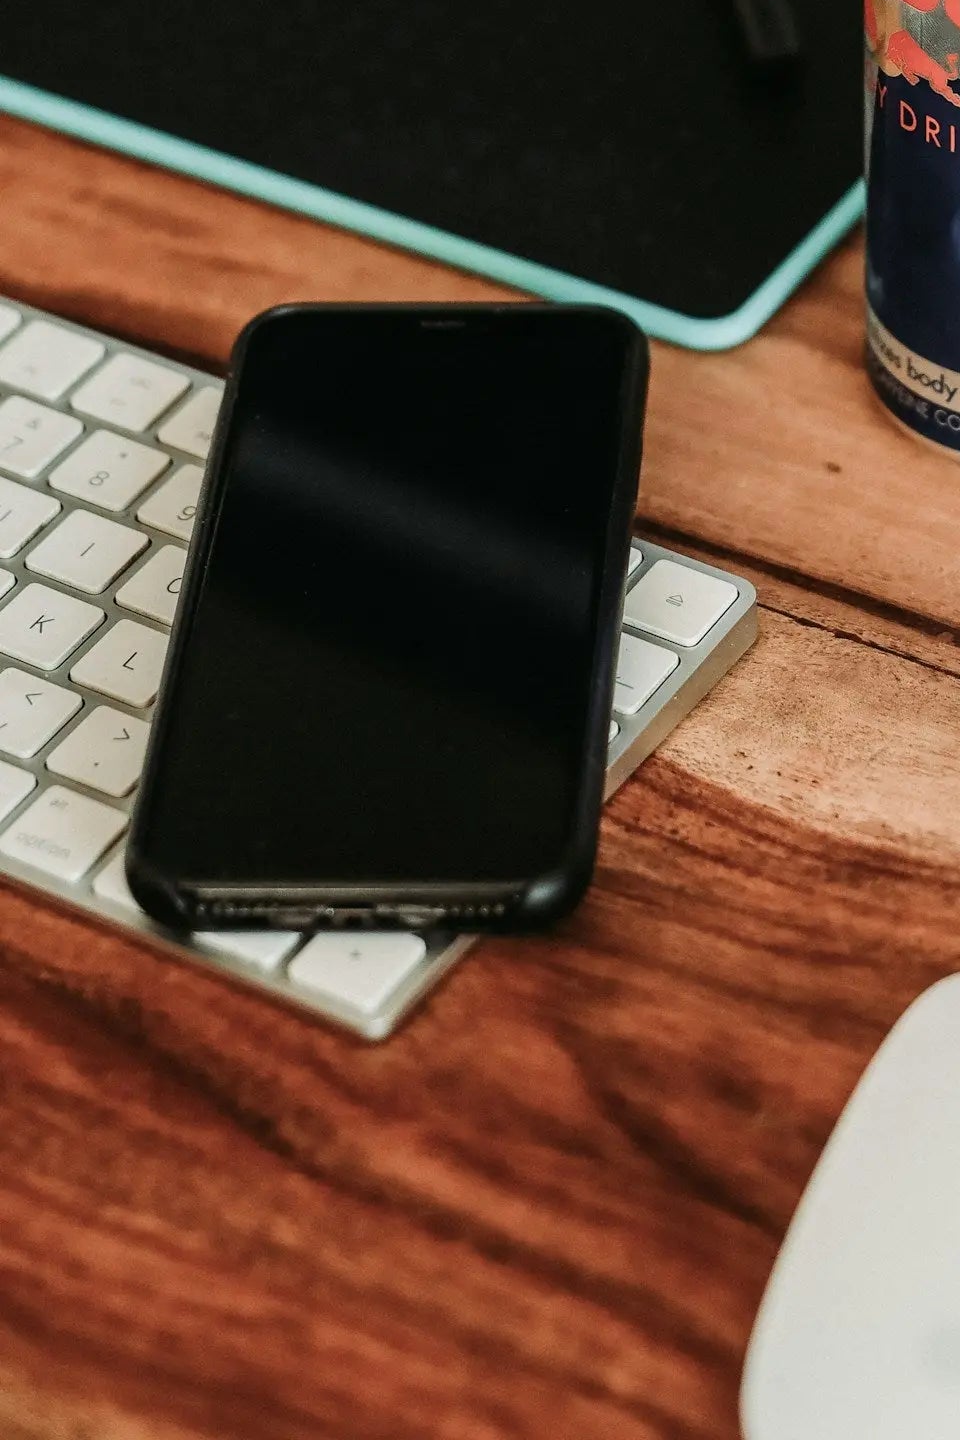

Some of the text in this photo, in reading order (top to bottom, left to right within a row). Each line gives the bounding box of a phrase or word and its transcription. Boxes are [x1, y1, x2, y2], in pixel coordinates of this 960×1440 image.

[906, 357, 958, 402] body
[89, 471, 110, 486] 8
[177, 505, 197, 521] 9
[29, 615, 55, 633] K
[122, 652, 138, 670] L
